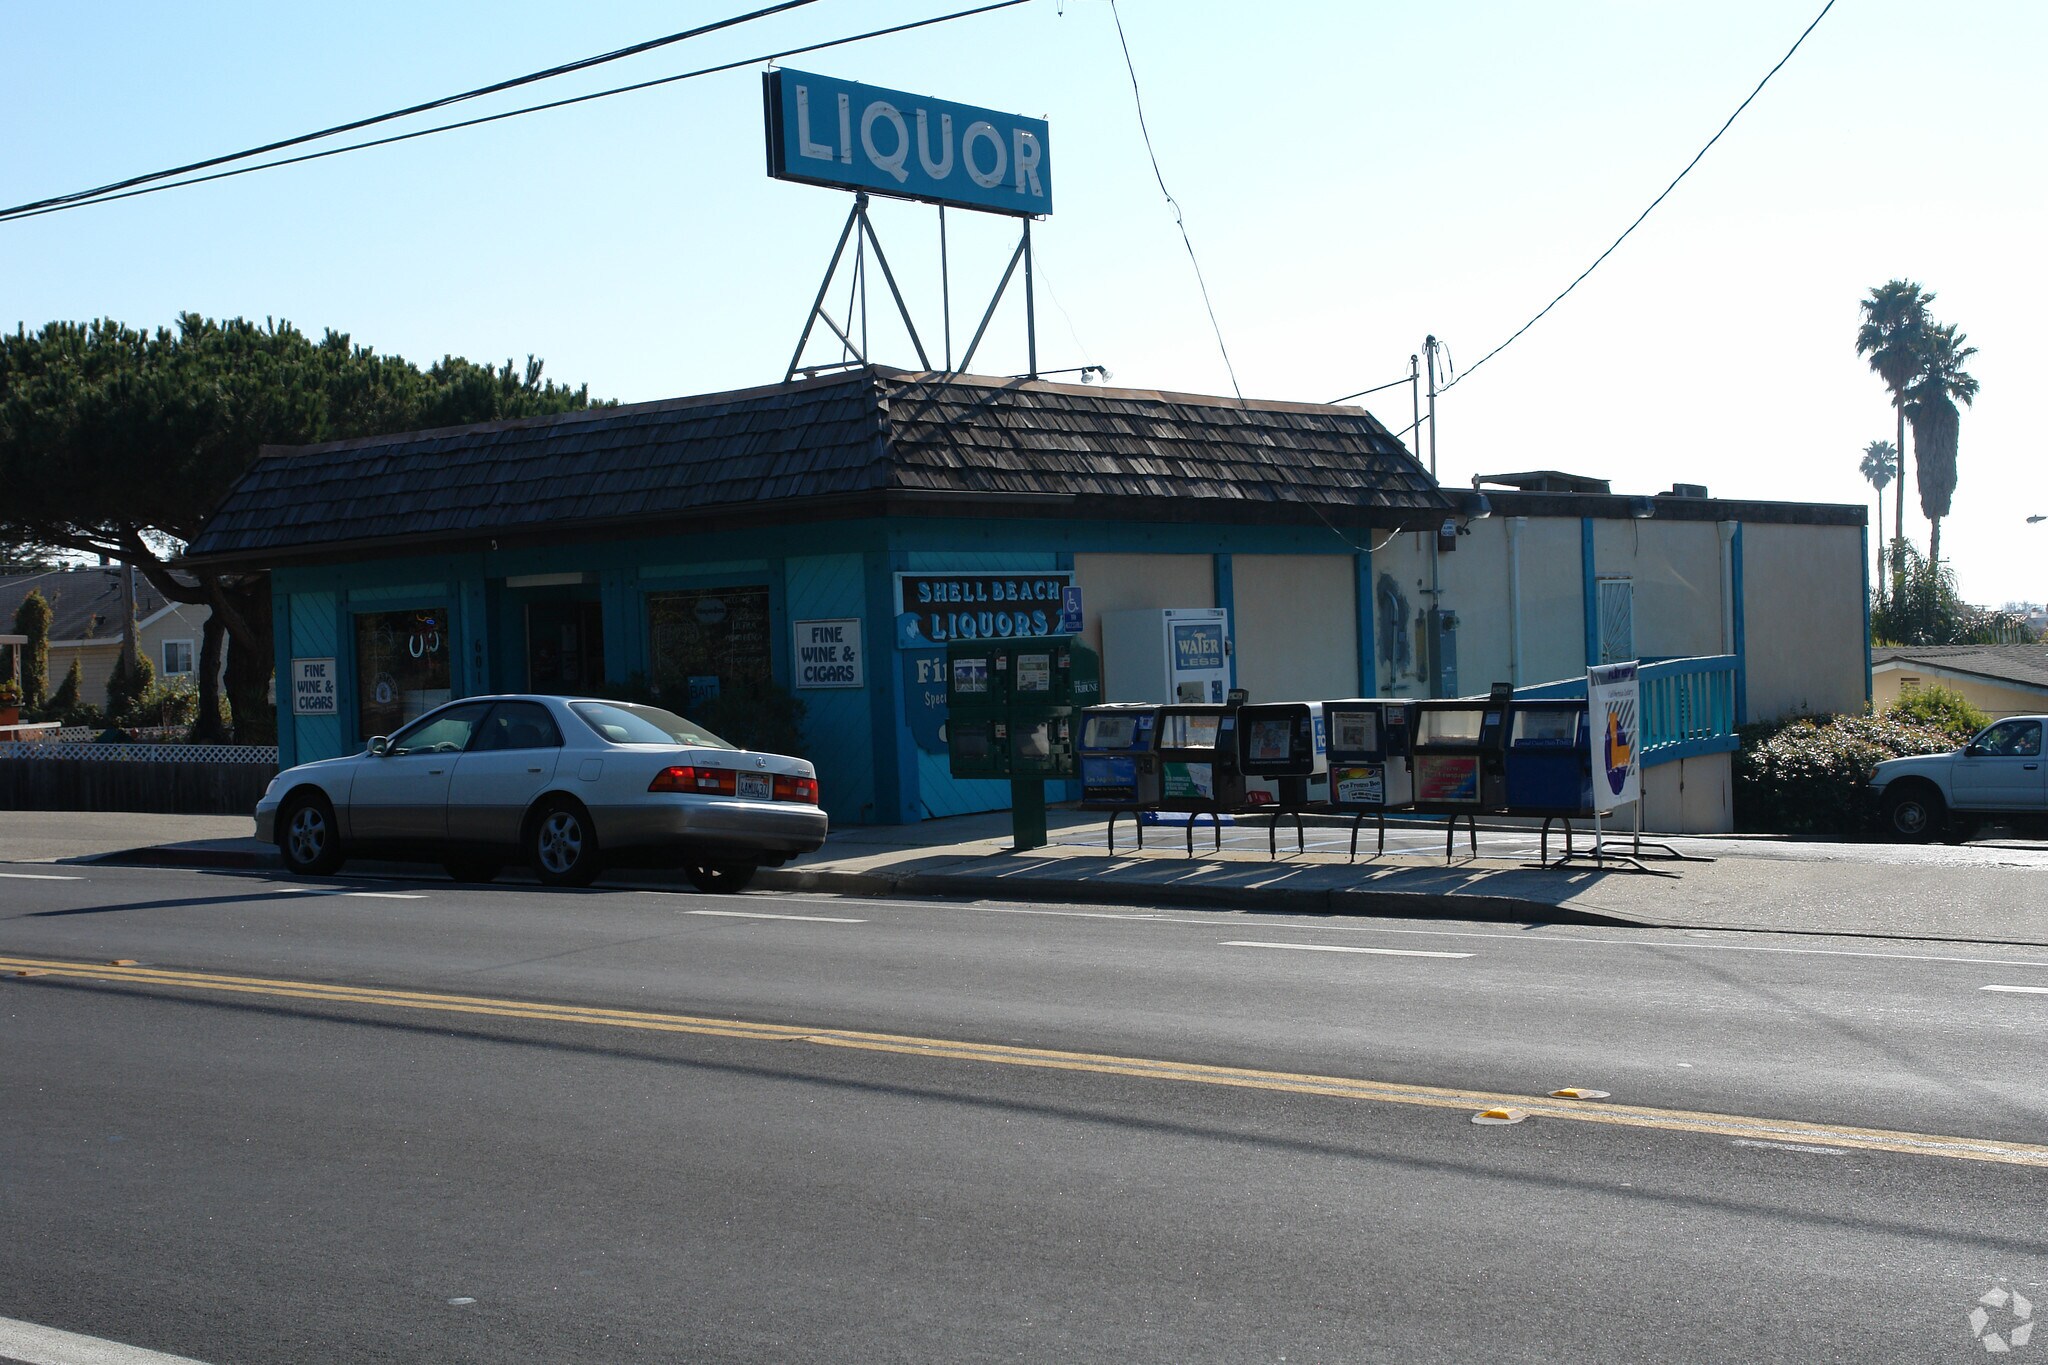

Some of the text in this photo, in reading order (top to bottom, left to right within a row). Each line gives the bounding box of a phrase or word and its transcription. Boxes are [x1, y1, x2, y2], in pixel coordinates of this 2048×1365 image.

[796, 85, 1043, 198] LIQUOR
[917, 580, 1060, 603] SHELL BEACH
[930, 609, 1048, 639] LIQUORS
[812, 627, 843, 643] FINE
[1178, 634, 1219, 655] WATER
[801, 645, 855, 663] WINE &
[1180, 657, 1220, 667] LESS
[304, 664, 326, 678] FINE
[804, 665, 854, 682] CIGARS
[297, 680, 334, 694] WINE &
[690, 685, 716, 699] BAIT
[299, 696, 333, 710] CIGARS
